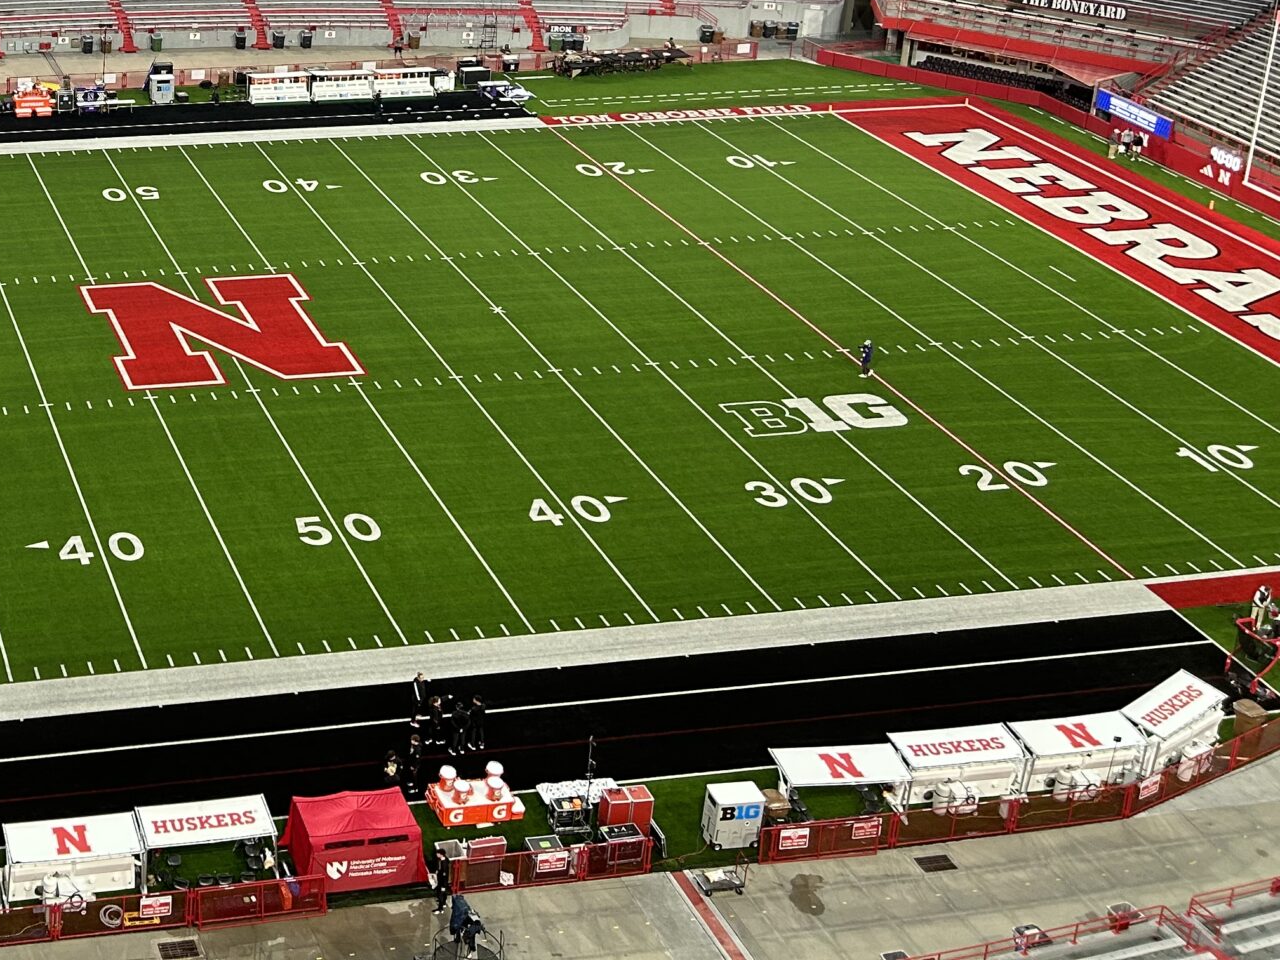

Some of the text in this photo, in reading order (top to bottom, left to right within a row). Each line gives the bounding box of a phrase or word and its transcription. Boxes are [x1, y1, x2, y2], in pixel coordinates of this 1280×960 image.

[550, 25, 572, 33] IRON
[552, 104, 812, 124] TOM OSBORNE FIELD
[575, 162, 635, 178] 20
[726, 154, 780, 169] 10
[262, 177, 320, 194] 40
[420, 170, 486, 186] 30
[1218, 169, 1231, 185] N
[102, 186, 159, 203] 50
[79, 274, 366, 390] N
[1176, 444, 1255, 472] 10
[958, 461, 1048, 491] 20
[744, 477, 831, 507] 30
[528, 495, 610, 526] 40
[294, 514, 381, 547] 50
[58, 531, 144, 566] 40
[1141, 685, 1203, 727] HUSKERS
[912, 737, 1006, 757] HUSKERS
[1054, 722, 1103, 748] N
[818, 753, 864, 779] N
[151, 810, 256, 835] HUSKERS
[449, 809, 463, 823] G
[493, 805, 507, 819] G
[51, 824, 92, 855] N
